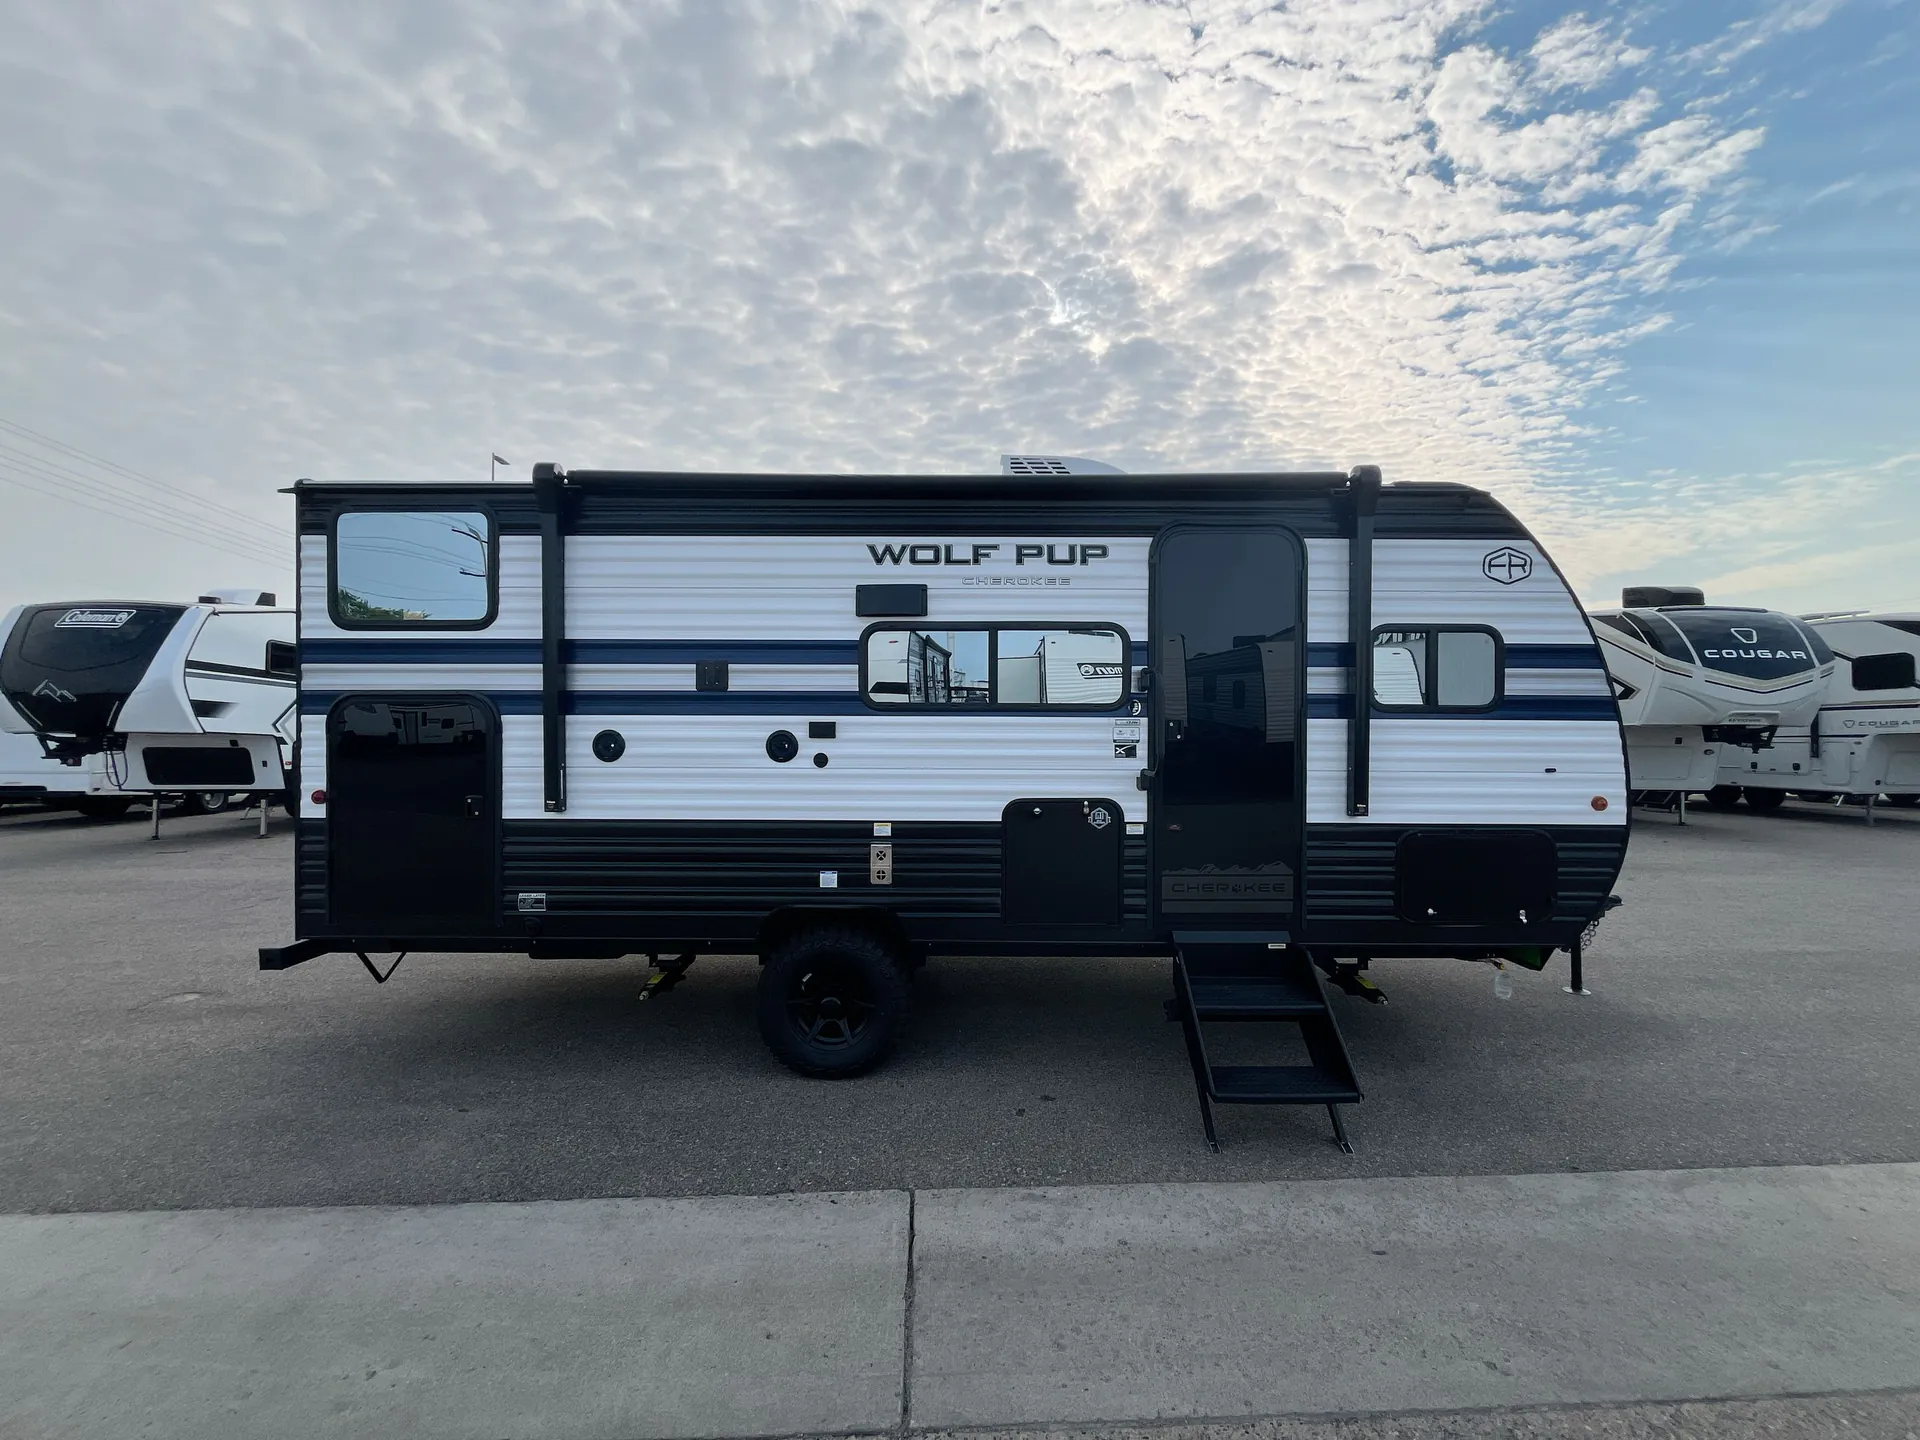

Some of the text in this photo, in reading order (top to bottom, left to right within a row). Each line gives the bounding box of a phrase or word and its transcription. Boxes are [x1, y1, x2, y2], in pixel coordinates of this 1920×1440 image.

[865, 543, 1110, 566] WOLF PUP
[961, 576, 1072, 586] CHEROKEE
[65, 610, 117, 622] Coleman
[1703, 649, 1808, 660] COUGAR
[1171, 882, 1287, 894] CHEROKEE
